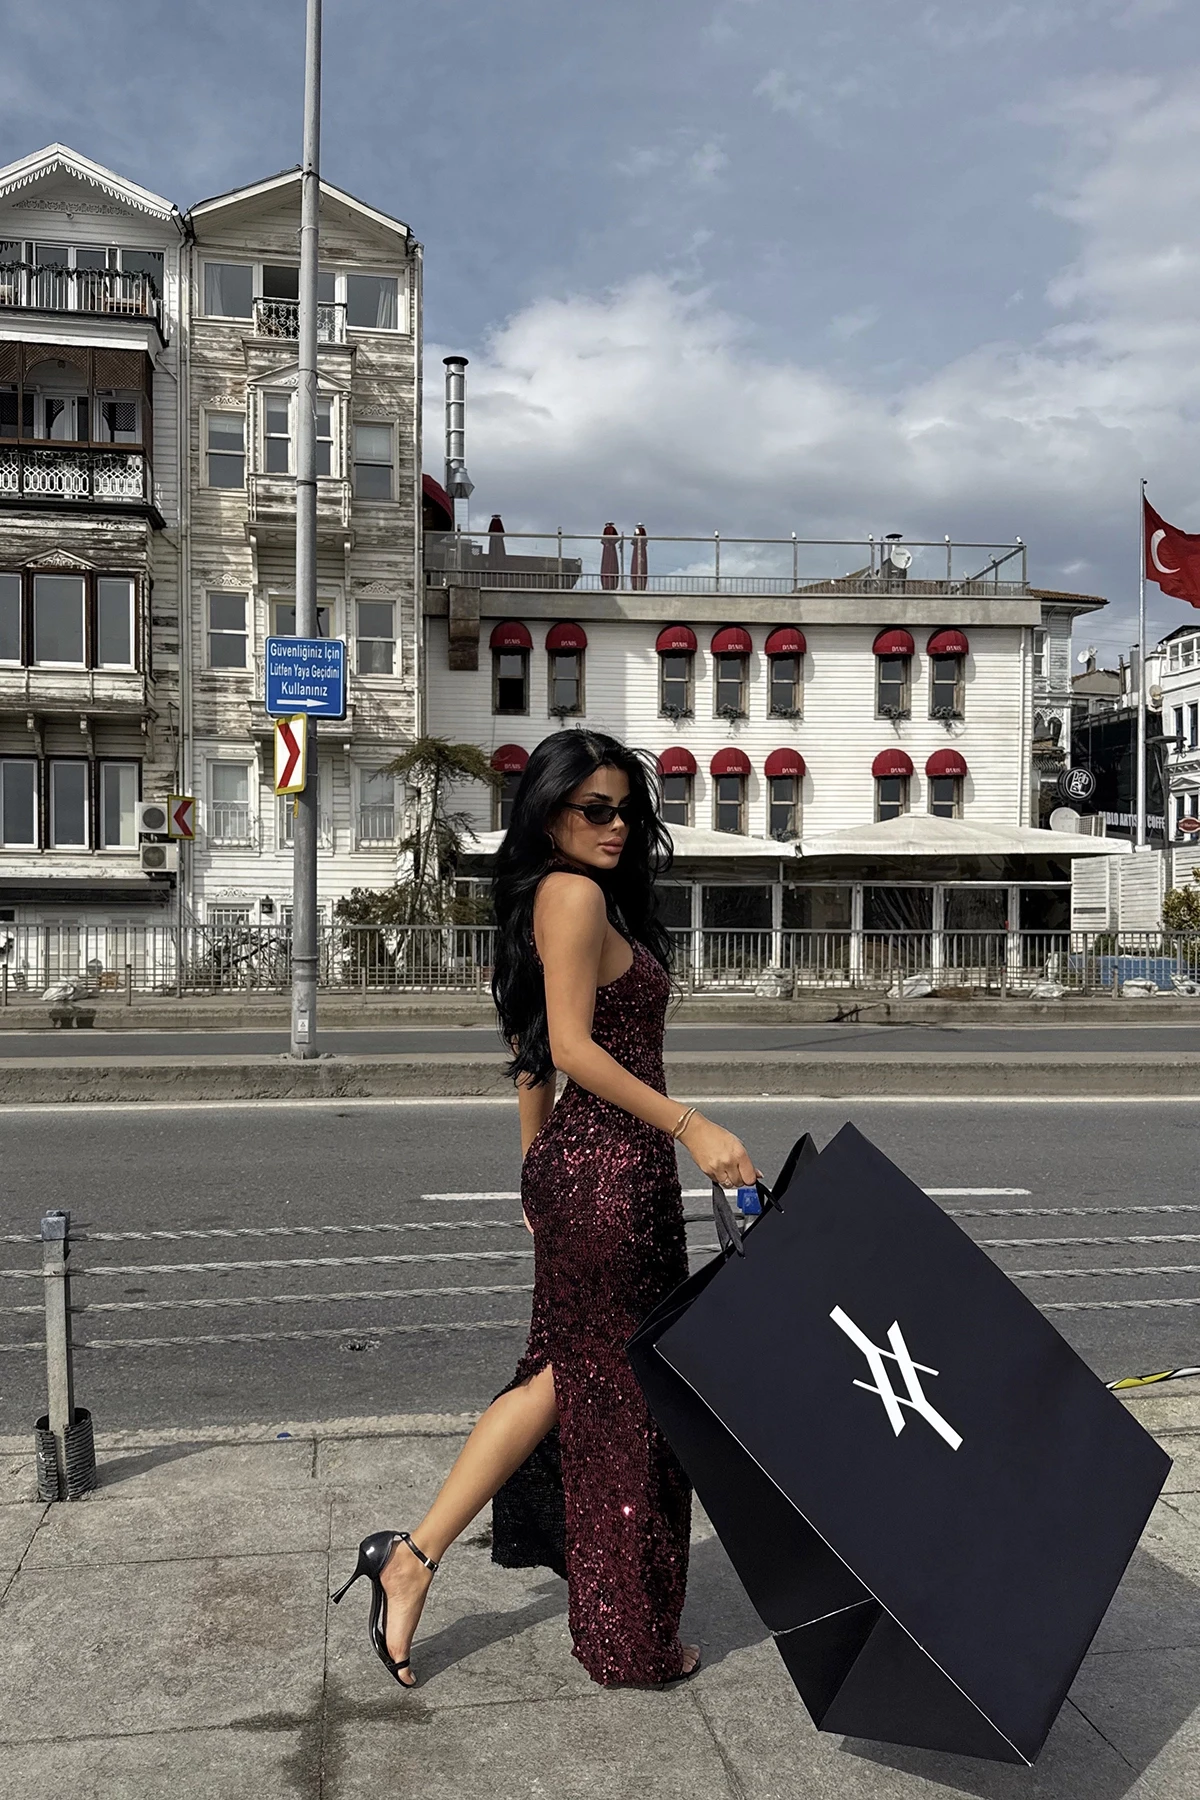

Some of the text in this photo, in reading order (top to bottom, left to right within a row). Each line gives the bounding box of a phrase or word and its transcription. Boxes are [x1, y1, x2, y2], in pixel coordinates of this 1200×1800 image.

[270, 643, 340, 662] Güvenliğiniz İçin
[270, 663, 340, 681] Lütfen Yaya Geçidini
[281, 682, 328, 697] Kullanınız
